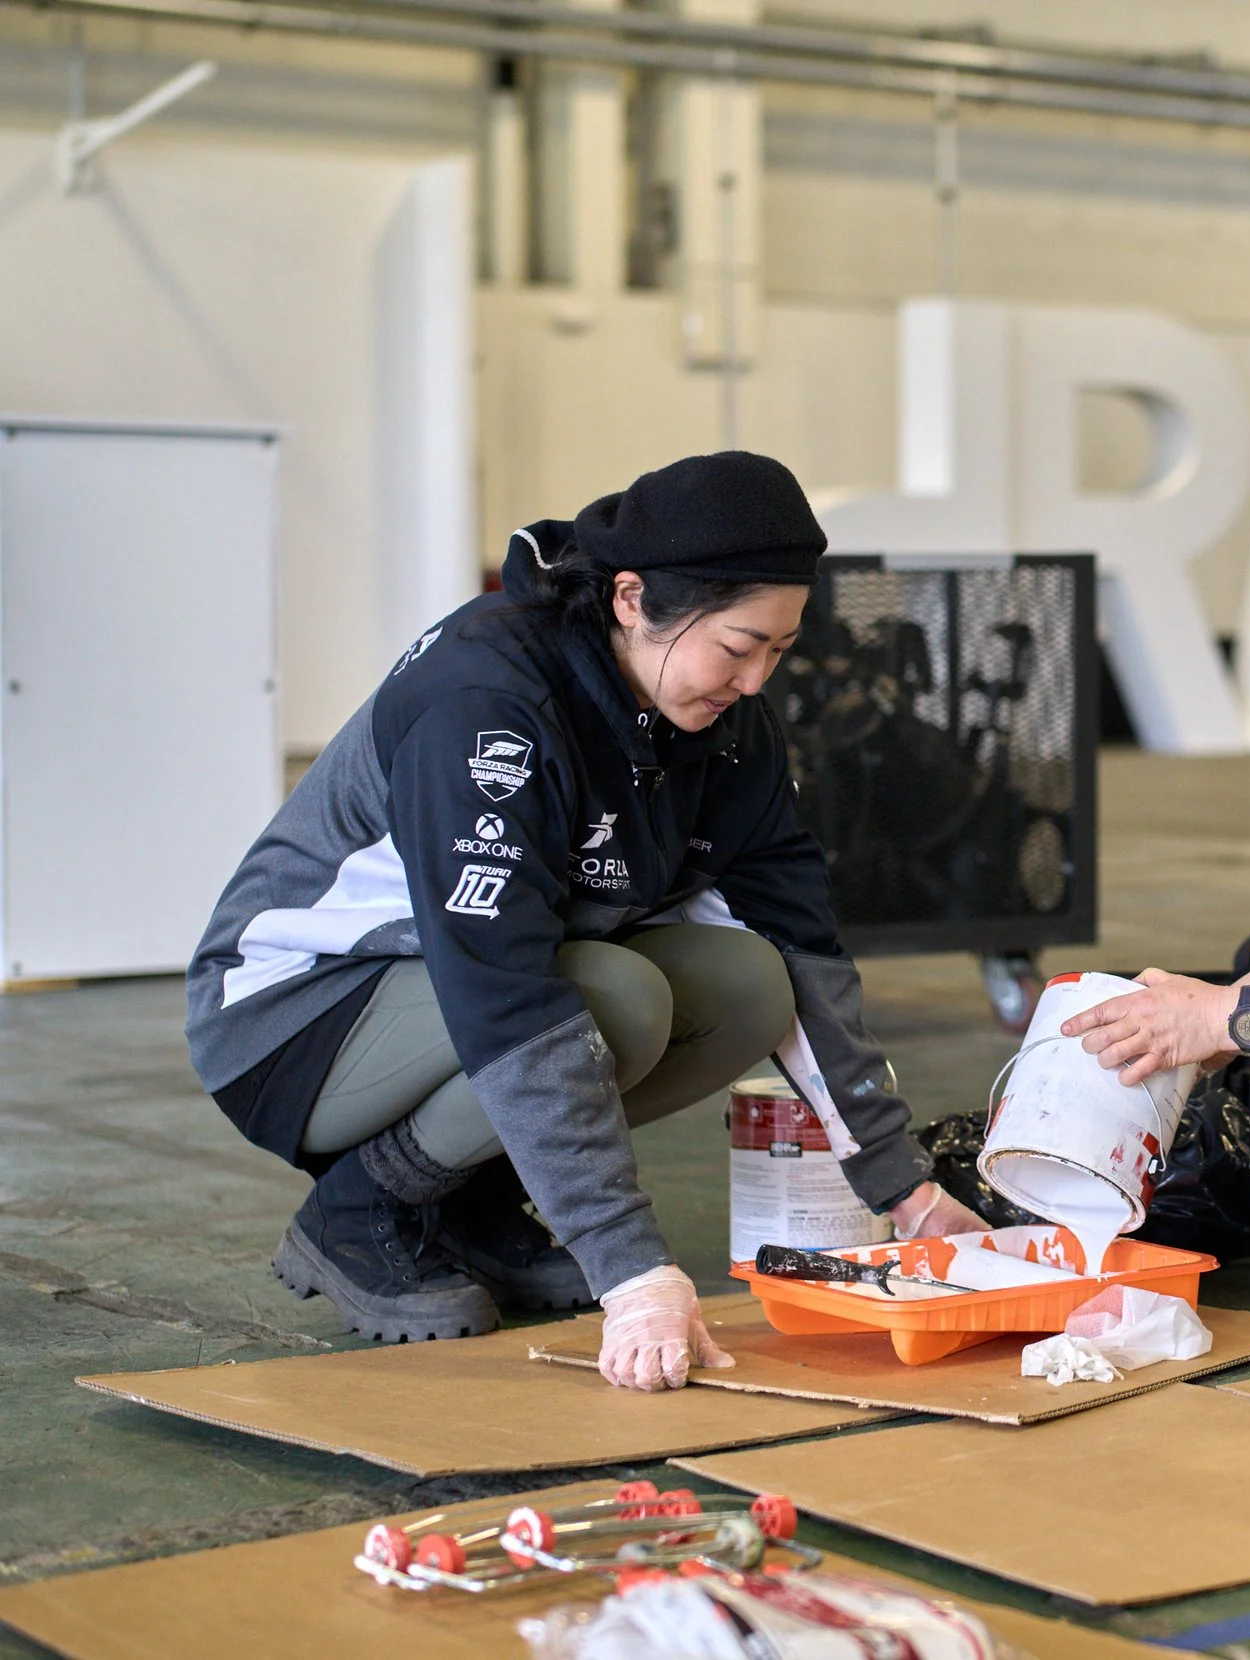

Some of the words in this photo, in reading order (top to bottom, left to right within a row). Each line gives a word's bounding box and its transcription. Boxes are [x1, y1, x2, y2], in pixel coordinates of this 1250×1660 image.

[471, 768, 526, 788] CHAMPIONSHIP
[472, 760, 499, 769] FORZA
[500, 764, 527, 776] RACING
[452, 838, 491, 855] XBOX
[492, 843, 523, 861] ONE
[457, 872, 506, 908] 10
